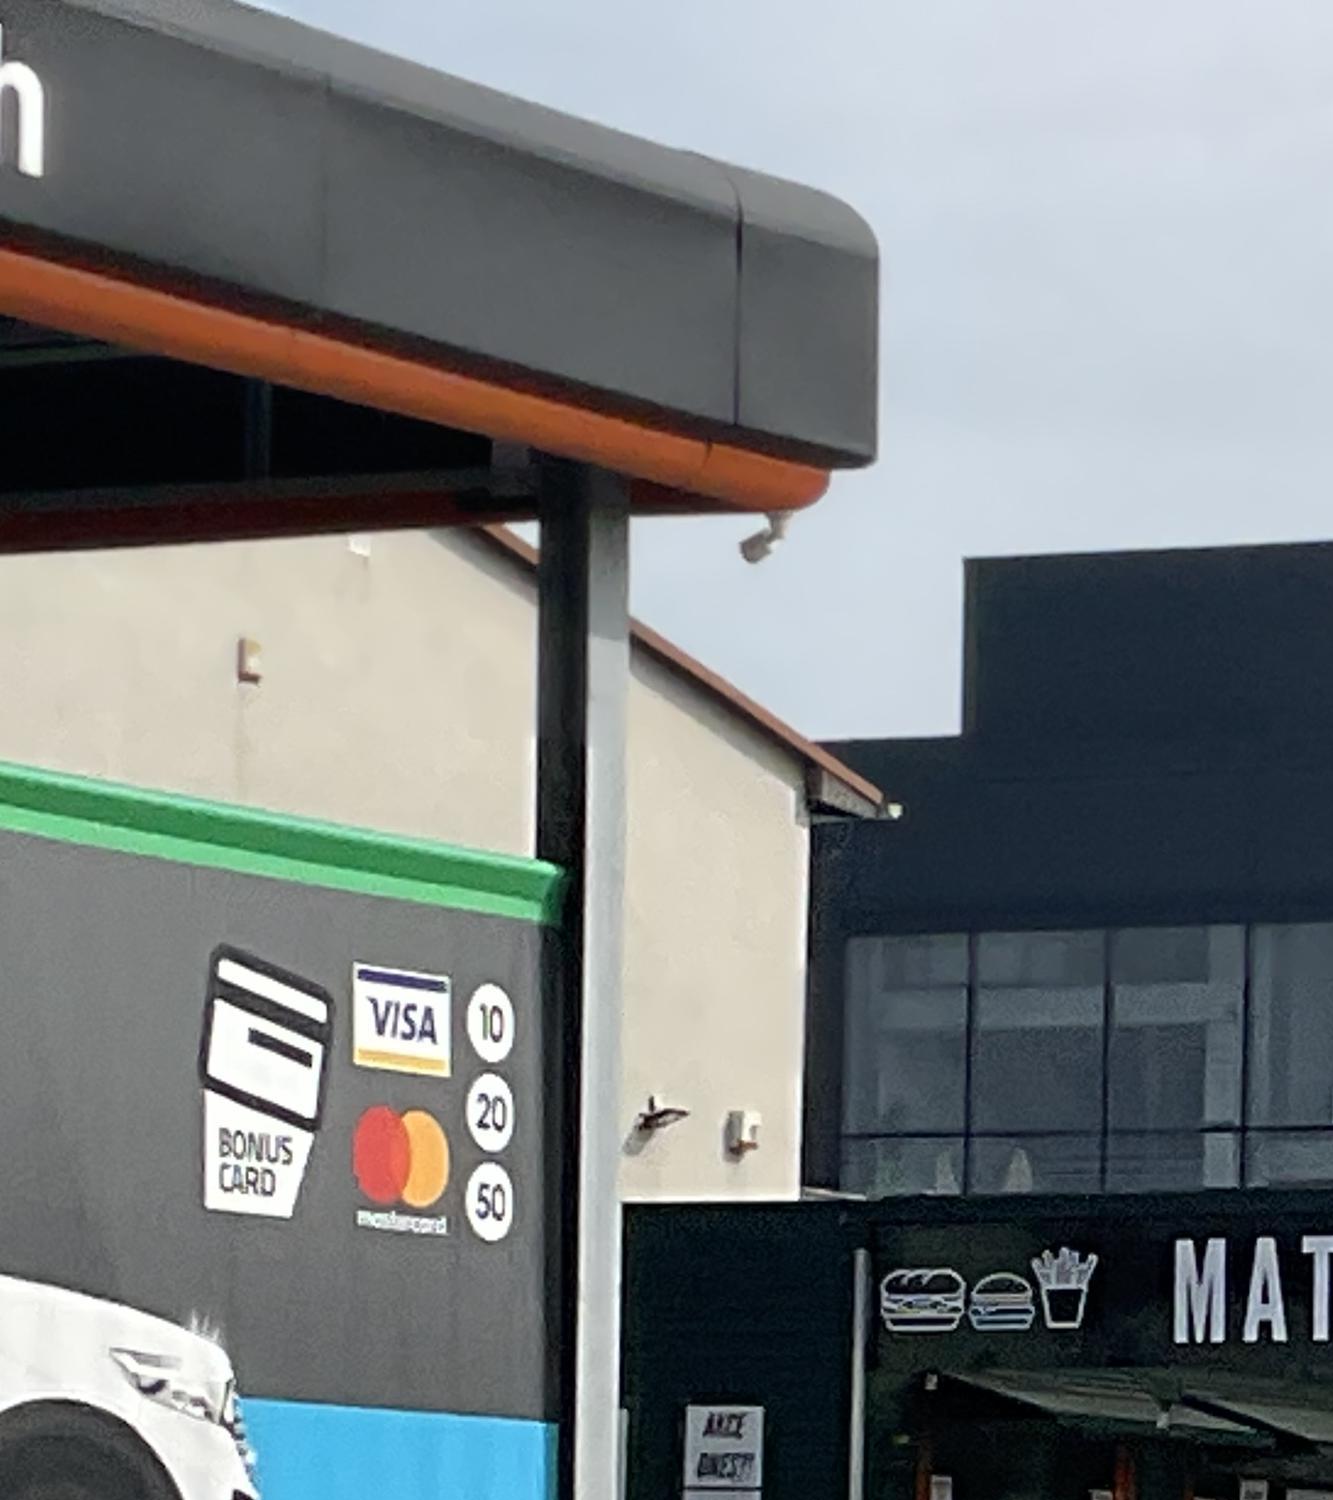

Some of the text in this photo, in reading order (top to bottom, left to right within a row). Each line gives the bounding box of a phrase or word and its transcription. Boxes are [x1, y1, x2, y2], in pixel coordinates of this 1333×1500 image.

[369, 997, 439, 1046] VISA
[480, 1004, 503, 1042] 10
[477, 1094, 506, 1132] 20
[219, 1128, 294, 1166] BONUS
[219, 1162, 276, 1197] CARD
[476, 1184, 505, 1222] 50
